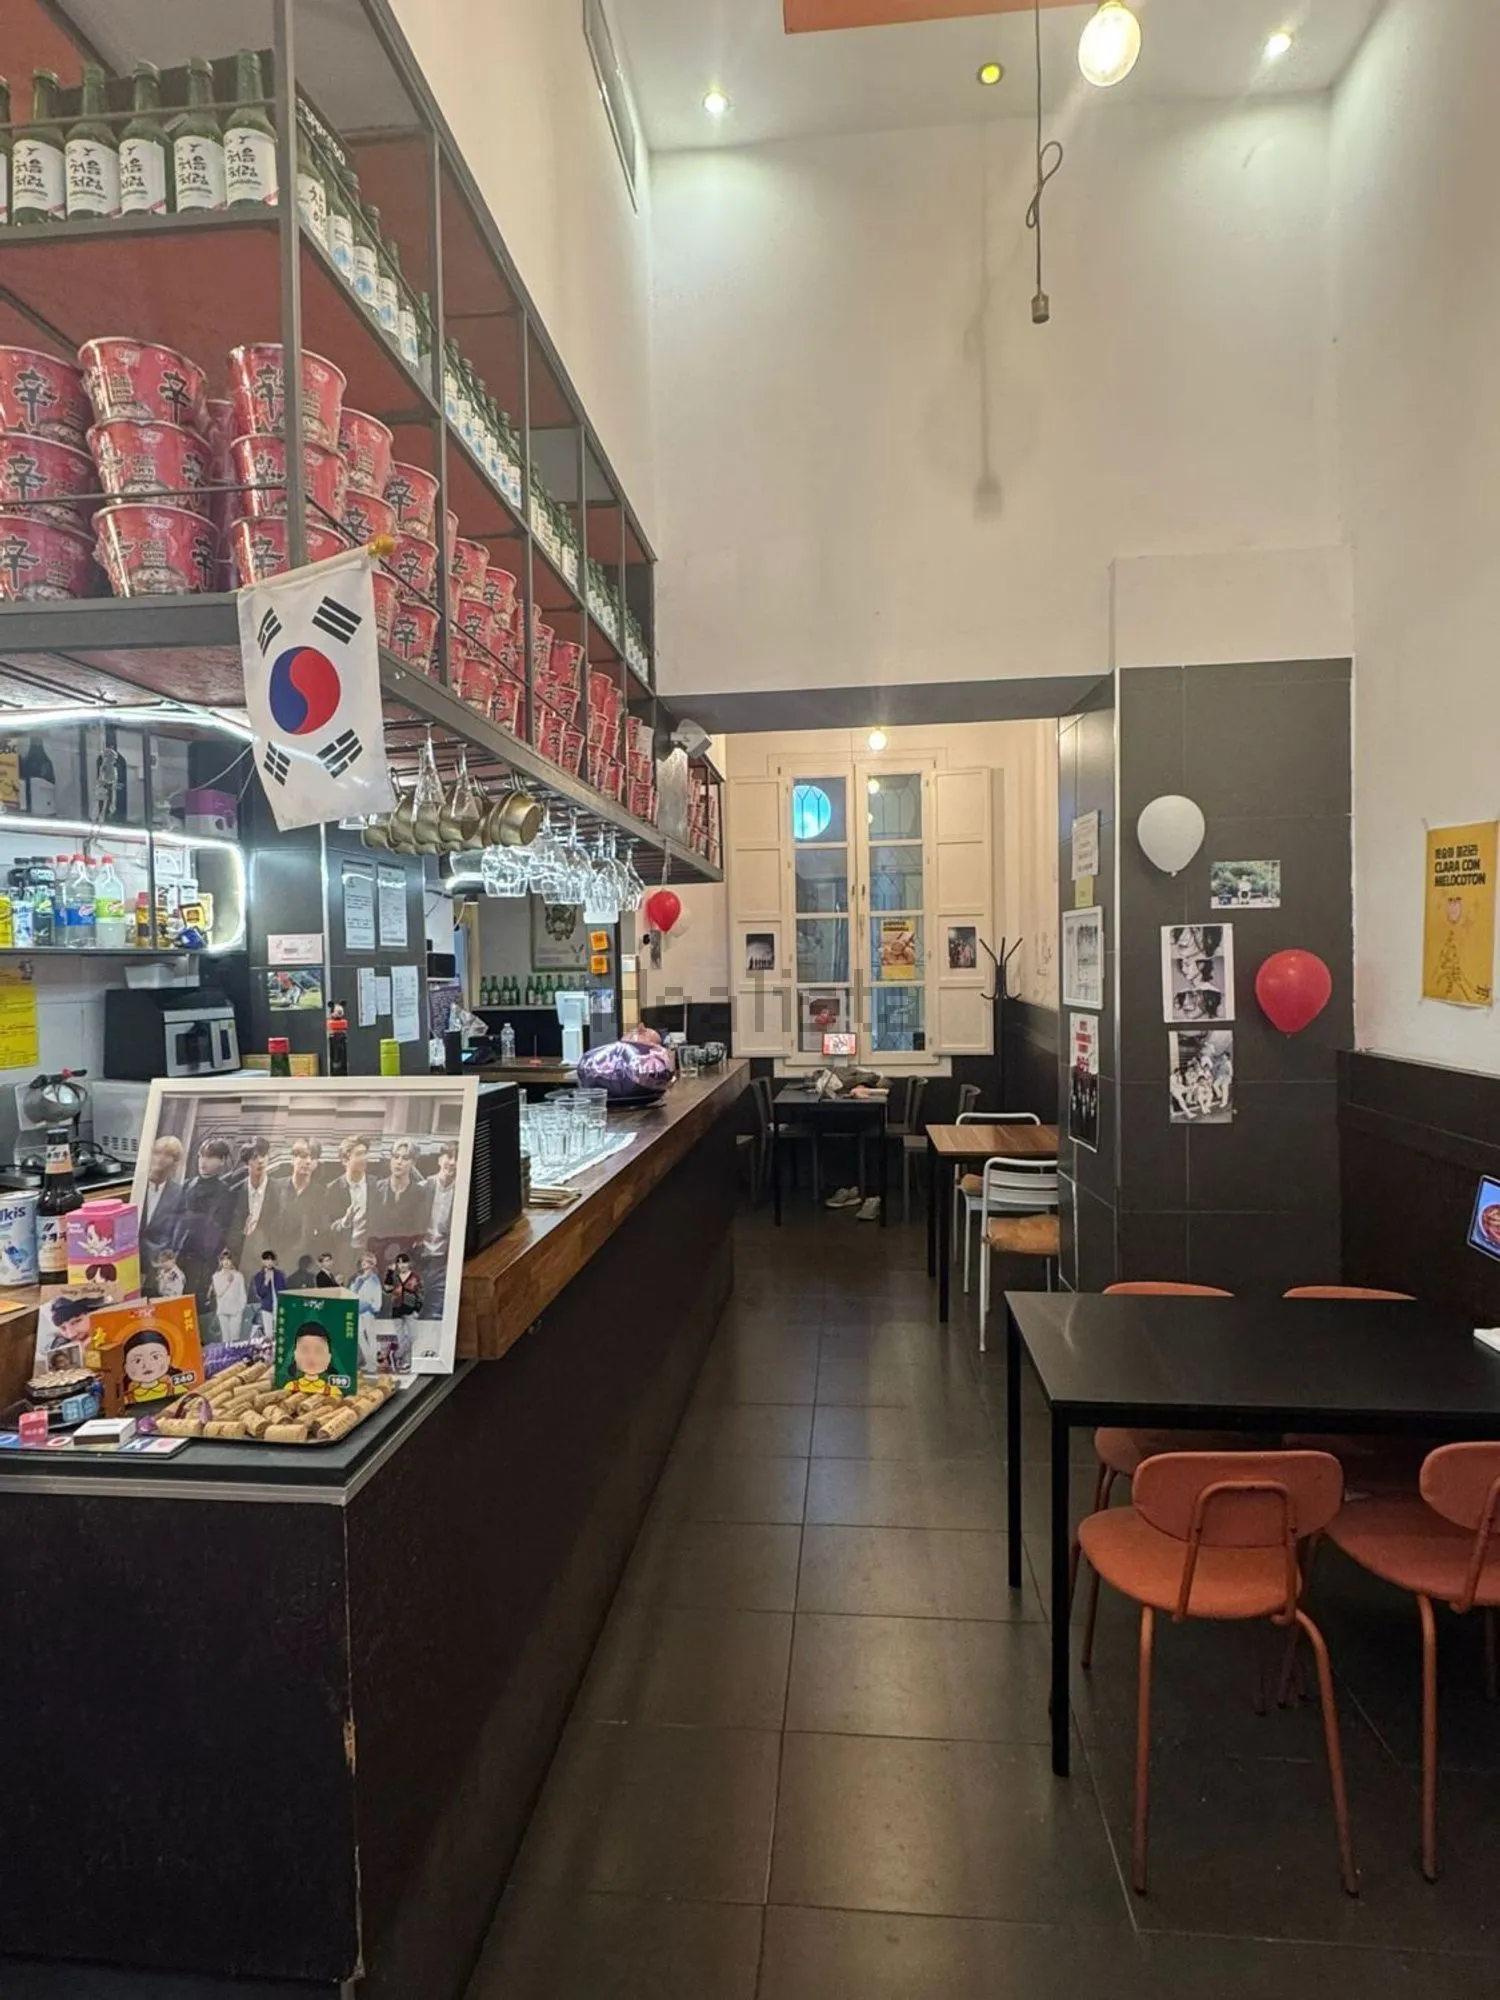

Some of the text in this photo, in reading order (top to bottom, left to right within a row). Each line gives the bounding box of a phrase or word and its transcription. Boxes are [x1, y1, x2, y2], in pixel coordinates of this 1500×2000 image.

[13, 367, 59, 425] 辛
[158, 370, 192, 425] 辛
[6, 453, 48, 500] 辛
[386, 478, 417, 522] 辛
[2, 536, 40, 590] 辛
[399, 548, 424, 582] 辛
[393, 616, 418, 659] 辛
[1434, 873, 1486, 887] MELOCOTON
[1435, 858, 1480, 873] CLARA CON
